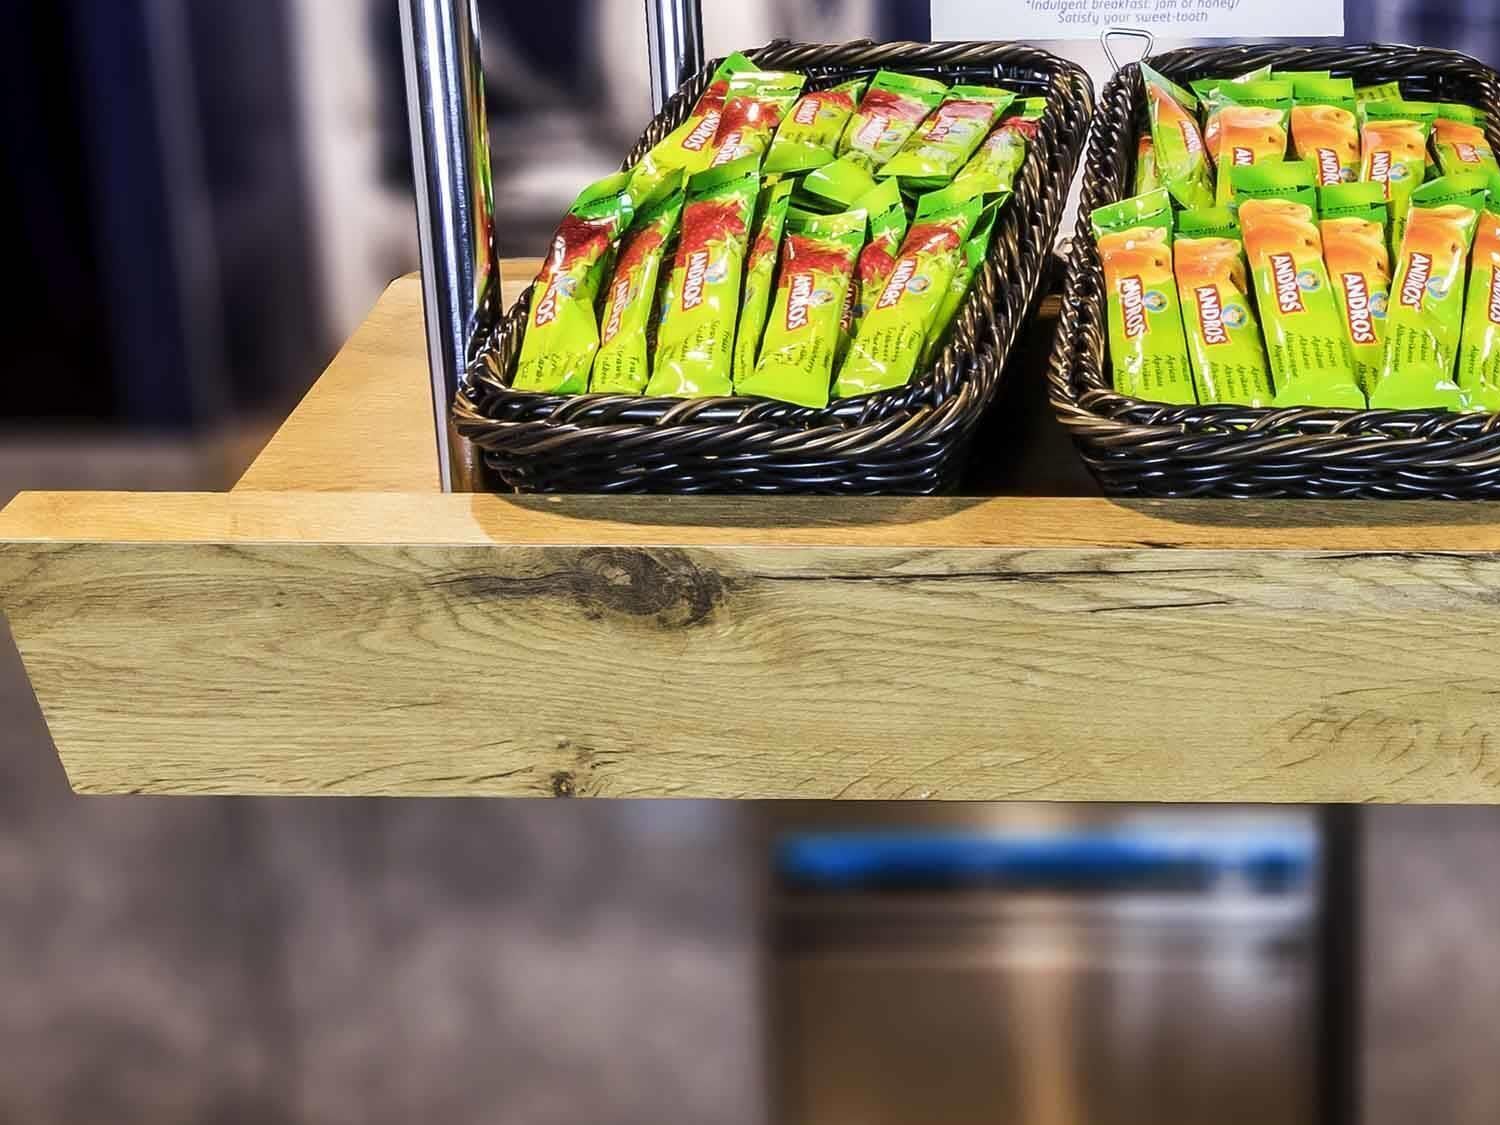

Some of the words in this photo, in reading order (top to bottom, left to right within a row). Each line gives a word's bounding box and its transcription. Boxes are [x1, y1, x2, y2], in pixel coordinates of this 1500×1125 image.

[1058, 12, 1099, 25] Satisfy
[1104, 14, 1129, 24] your
[1136, 12, 1209, 23] sweet-tooth
[683, 253, 707, 309] ANDROS
[1273, 255, 1300, 313] ANDROS
[1344, 274, 1373, 343] ANDROS
[1402, 254, 1430, 306] ANDROS
[1197, 287, 1226, 345] ANDROS
